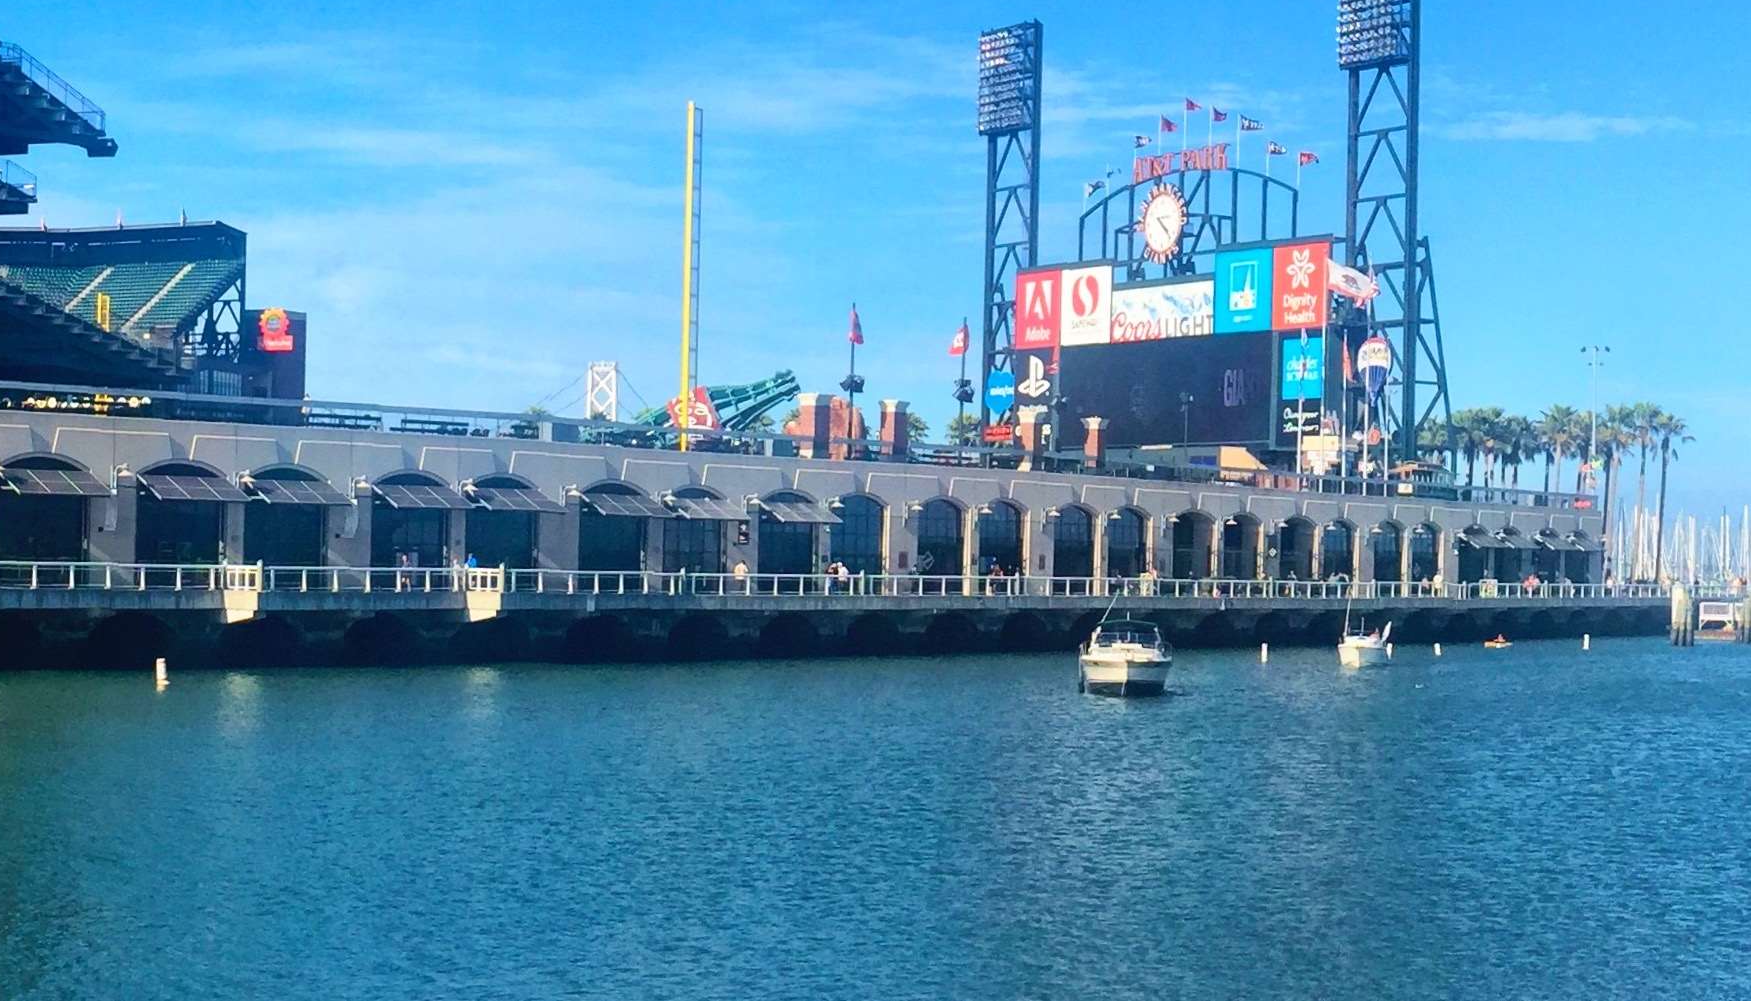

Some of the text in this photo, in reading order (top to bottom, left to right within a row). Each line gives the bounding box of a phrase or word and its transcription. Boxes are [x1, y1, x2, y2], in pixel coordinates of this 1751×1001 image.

[1133, 143, 1229, 184] AT&T PARK
[1283, 292, 1317, 311] Dignity
[1111, 311, 1214, 343] Coors LIGHT
[1284, 310, 1316, 325] Health
[1025, 326, 1051, 342] Adobe
